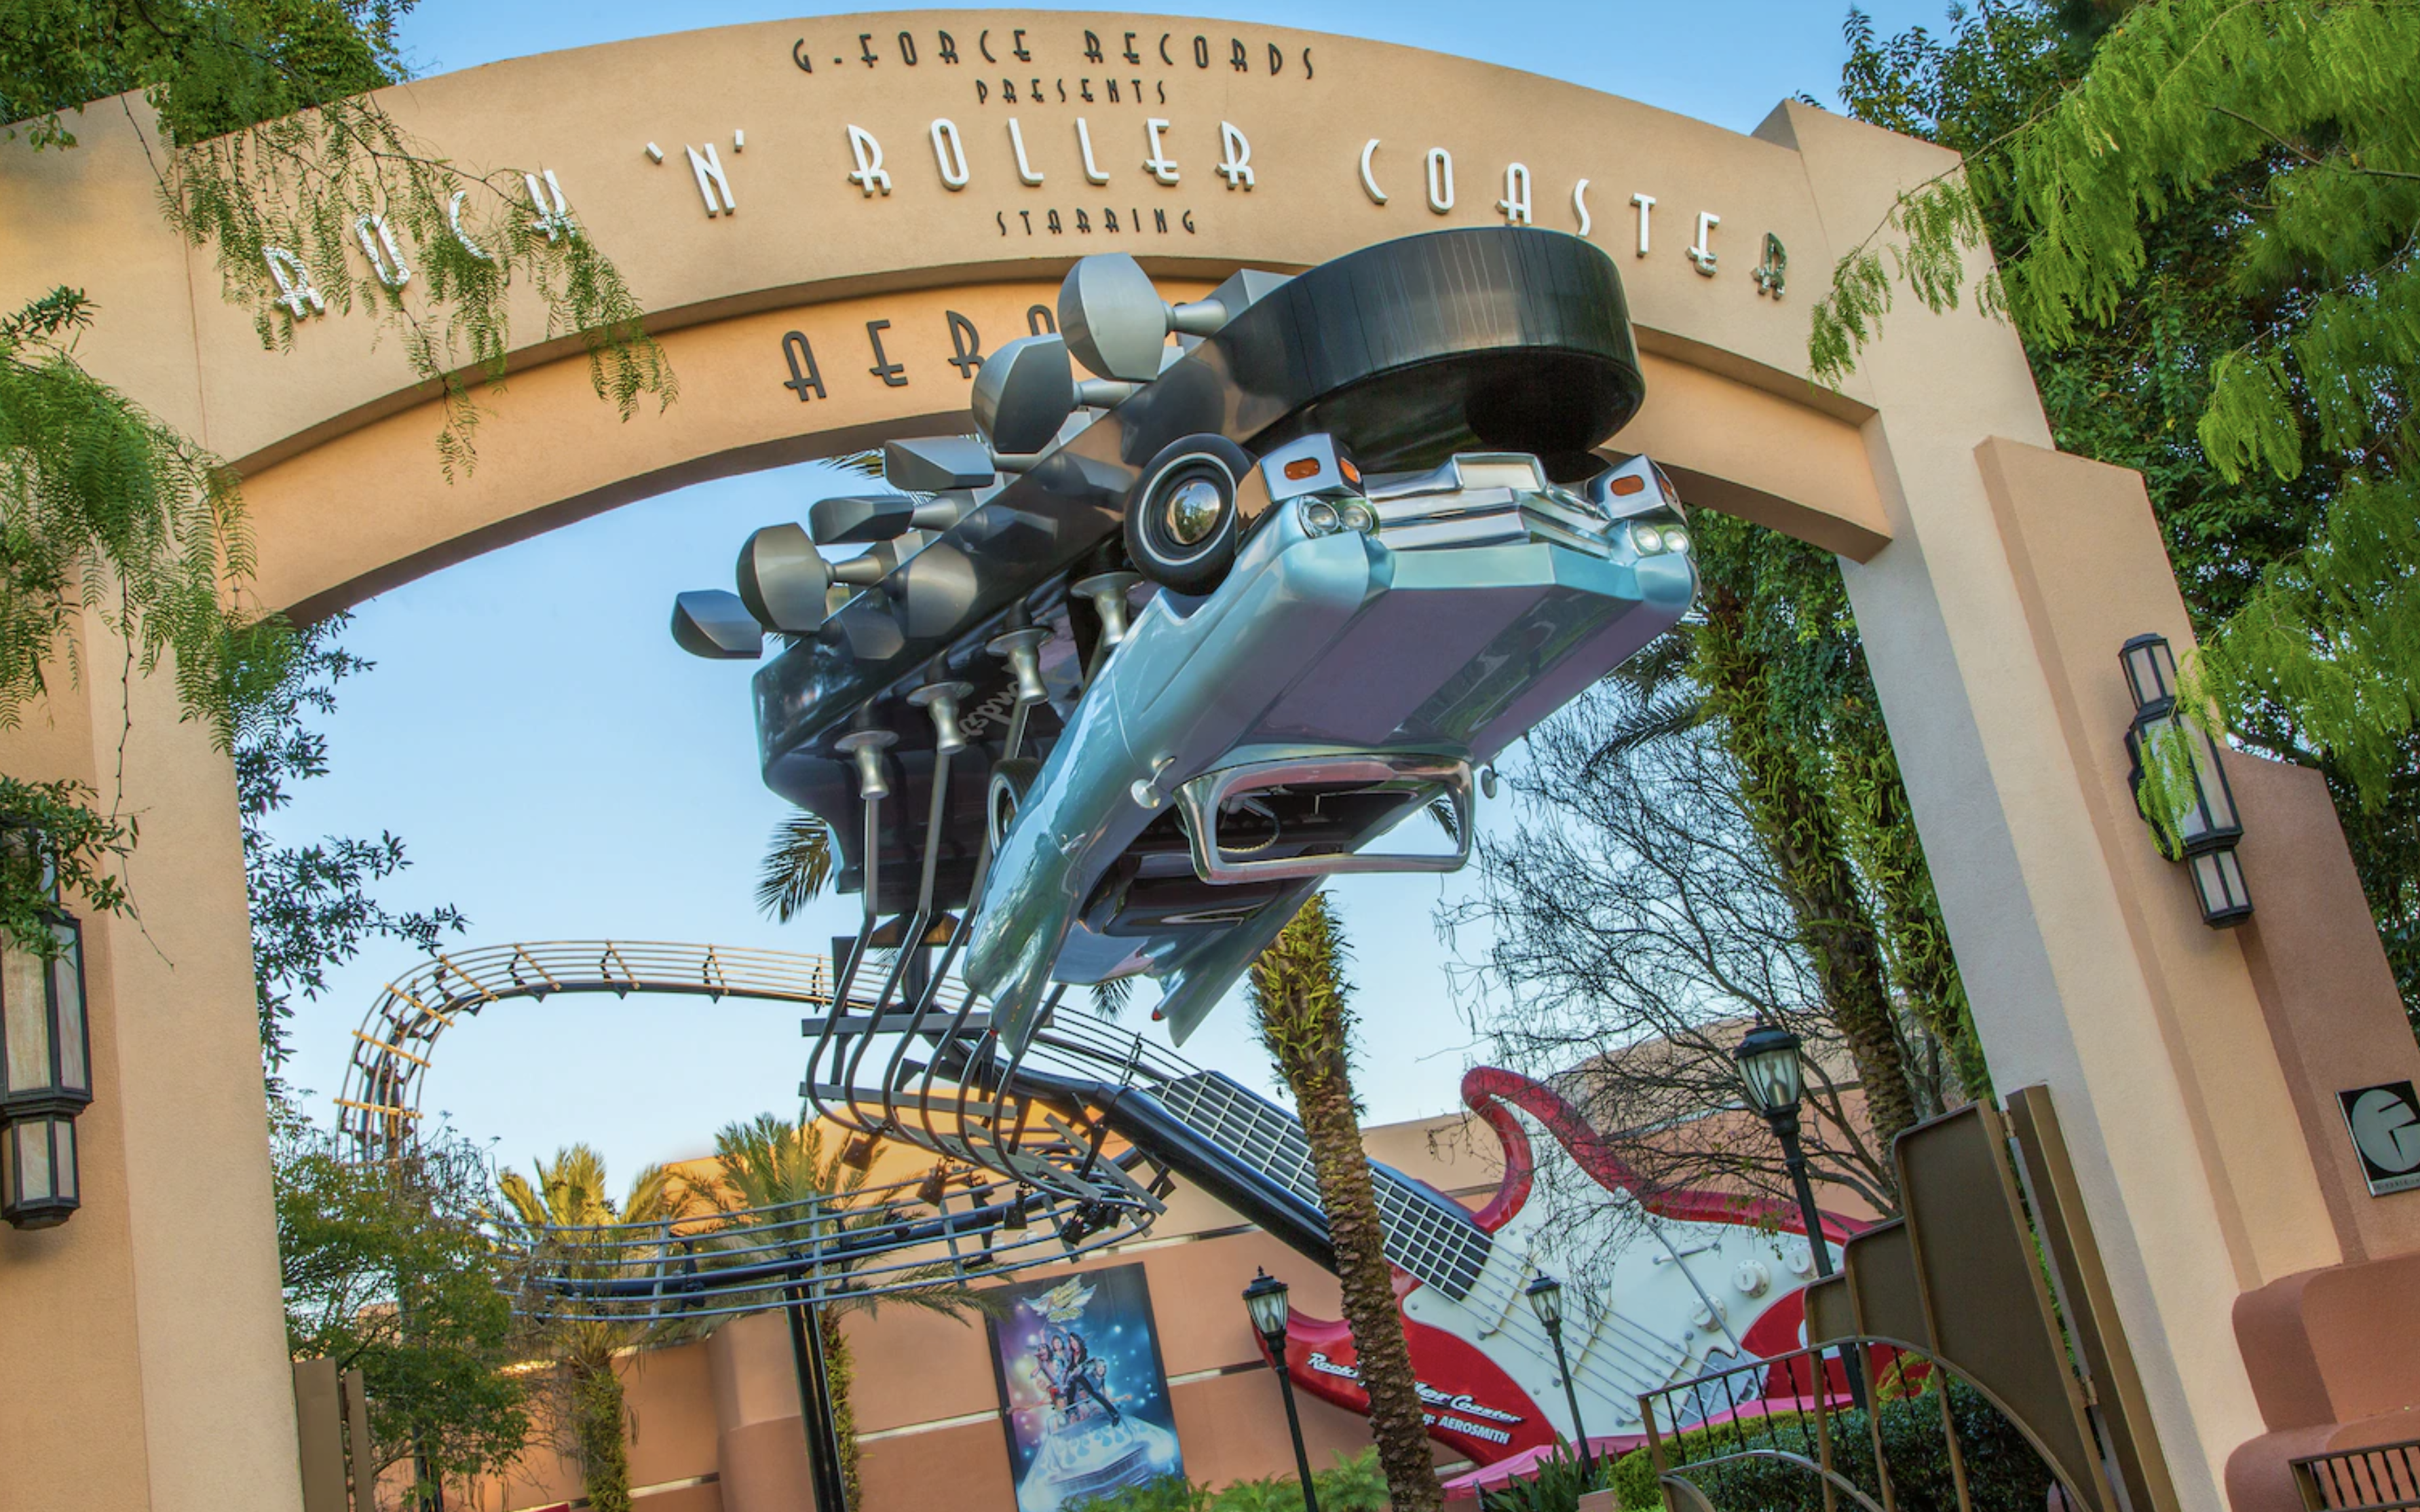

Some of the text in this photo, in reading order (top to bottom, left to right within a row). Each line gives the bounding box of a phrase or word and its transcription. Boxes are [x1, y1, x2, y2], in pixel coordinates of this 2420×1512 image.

[792, 29, 1314, 79] G-FORCE RECORDS
[976, 78, 1166, 104] PRESENTS
[261, 169, 576, 321] ROCK
[846, 117, 1256, 197] ROLLER
[1358, 138, 1788, 300] COASTER
[996, 208, 1196, 236] STARRING
[1450, 1395, 1524, 1423] Coaster
[1438, 1416, 1511, 1445] AEROSMITH
